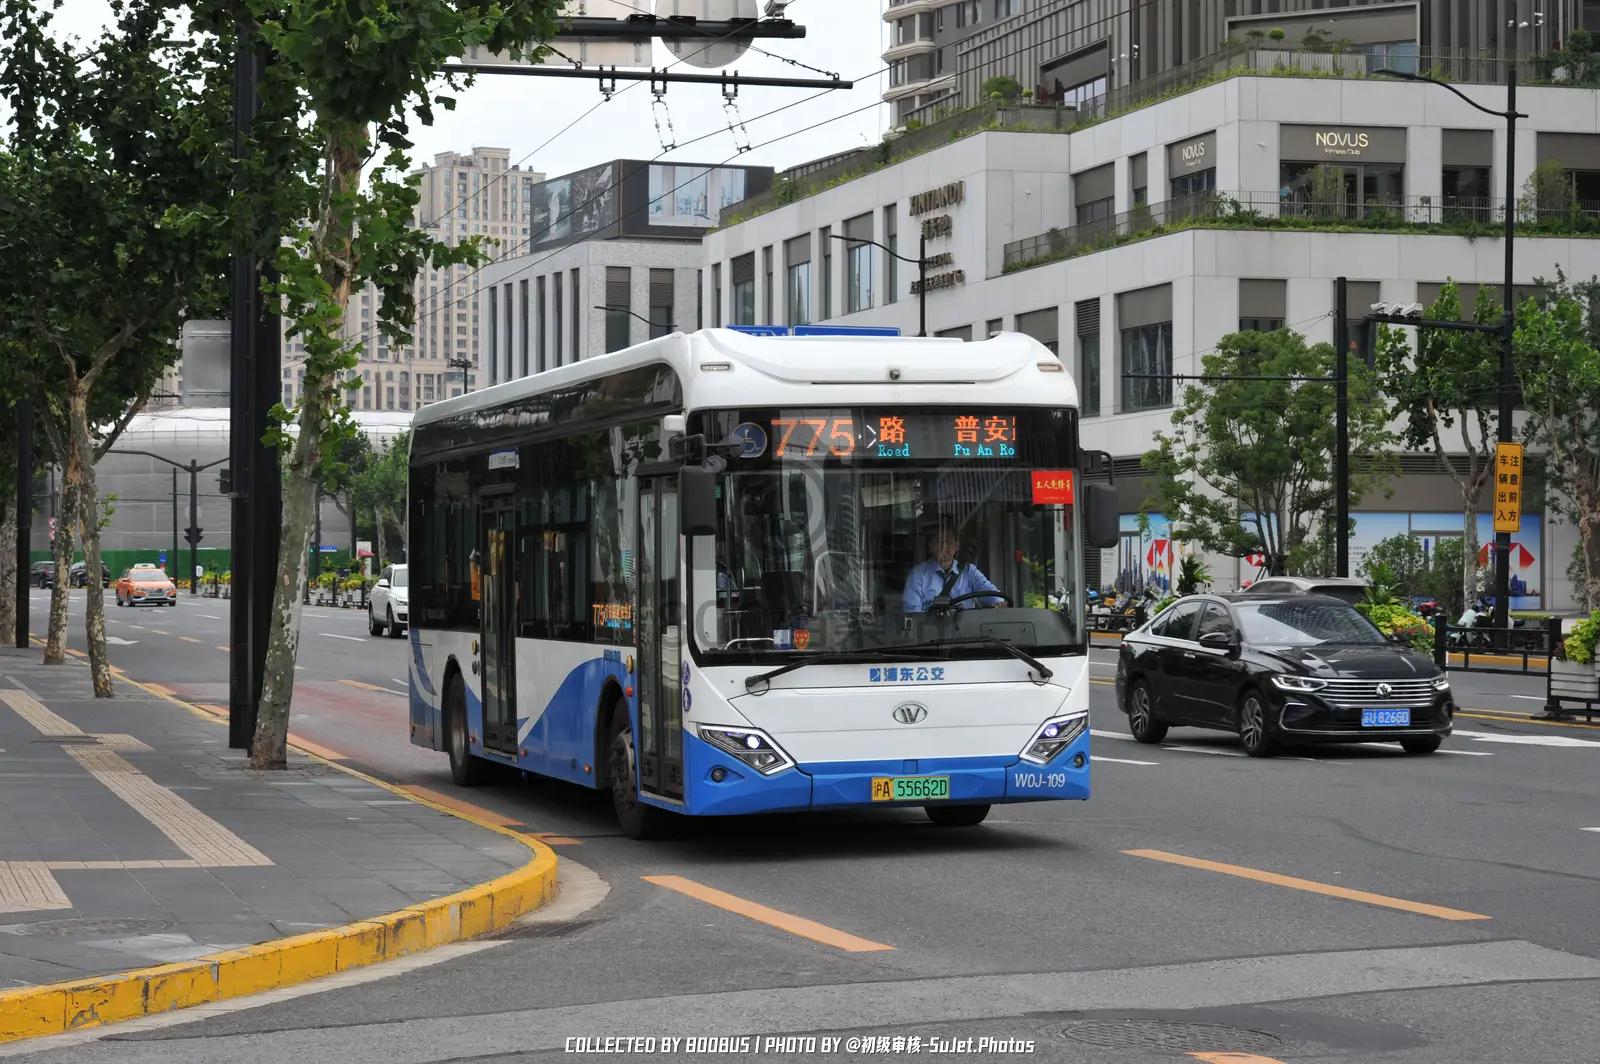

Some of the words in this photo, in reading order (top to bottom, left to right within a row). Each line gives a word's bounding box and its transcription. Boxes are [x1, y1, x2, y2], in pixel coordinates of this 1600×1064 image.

[1316, 132, 1368, 147] NOVUS
[1182, 142, 1205, 161] NOVUS
[771, 419, 855, 456] 775
[879, 416, 906, 443] 路
[954, 416, 1016, 443] 普安
[878, 443, 910, 457] Road
[954, 444, 970, 456] Pu
[977, 444, 993, 456] An
[1497, 455, 1509, 521] 车辆出入
[1508, 455, 1519, 521] 注意前方
[883, 667, 945, 682] 浦东公交
[873, 782, 891, 798] 沪A
[897, 779, 948, 797] 55662D
